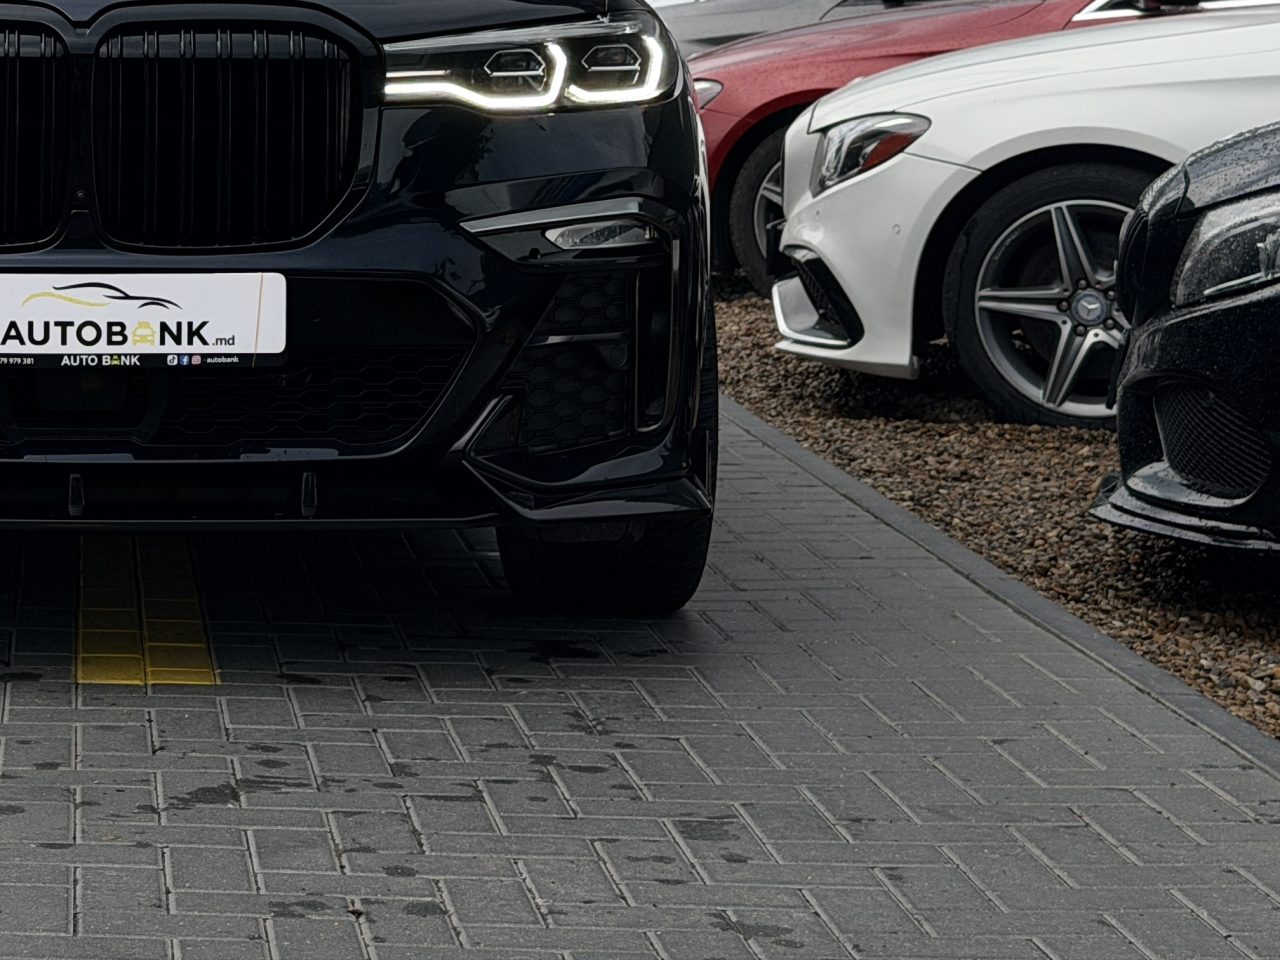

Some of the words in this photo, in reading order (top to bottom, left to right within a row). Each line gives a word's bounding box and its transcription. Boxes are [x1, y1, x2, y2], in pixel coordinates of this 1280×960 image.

[8, 357, 21, 365] 979
[22, 357, 35, 365] 381
[60, 355, 99, 366] AUTO
